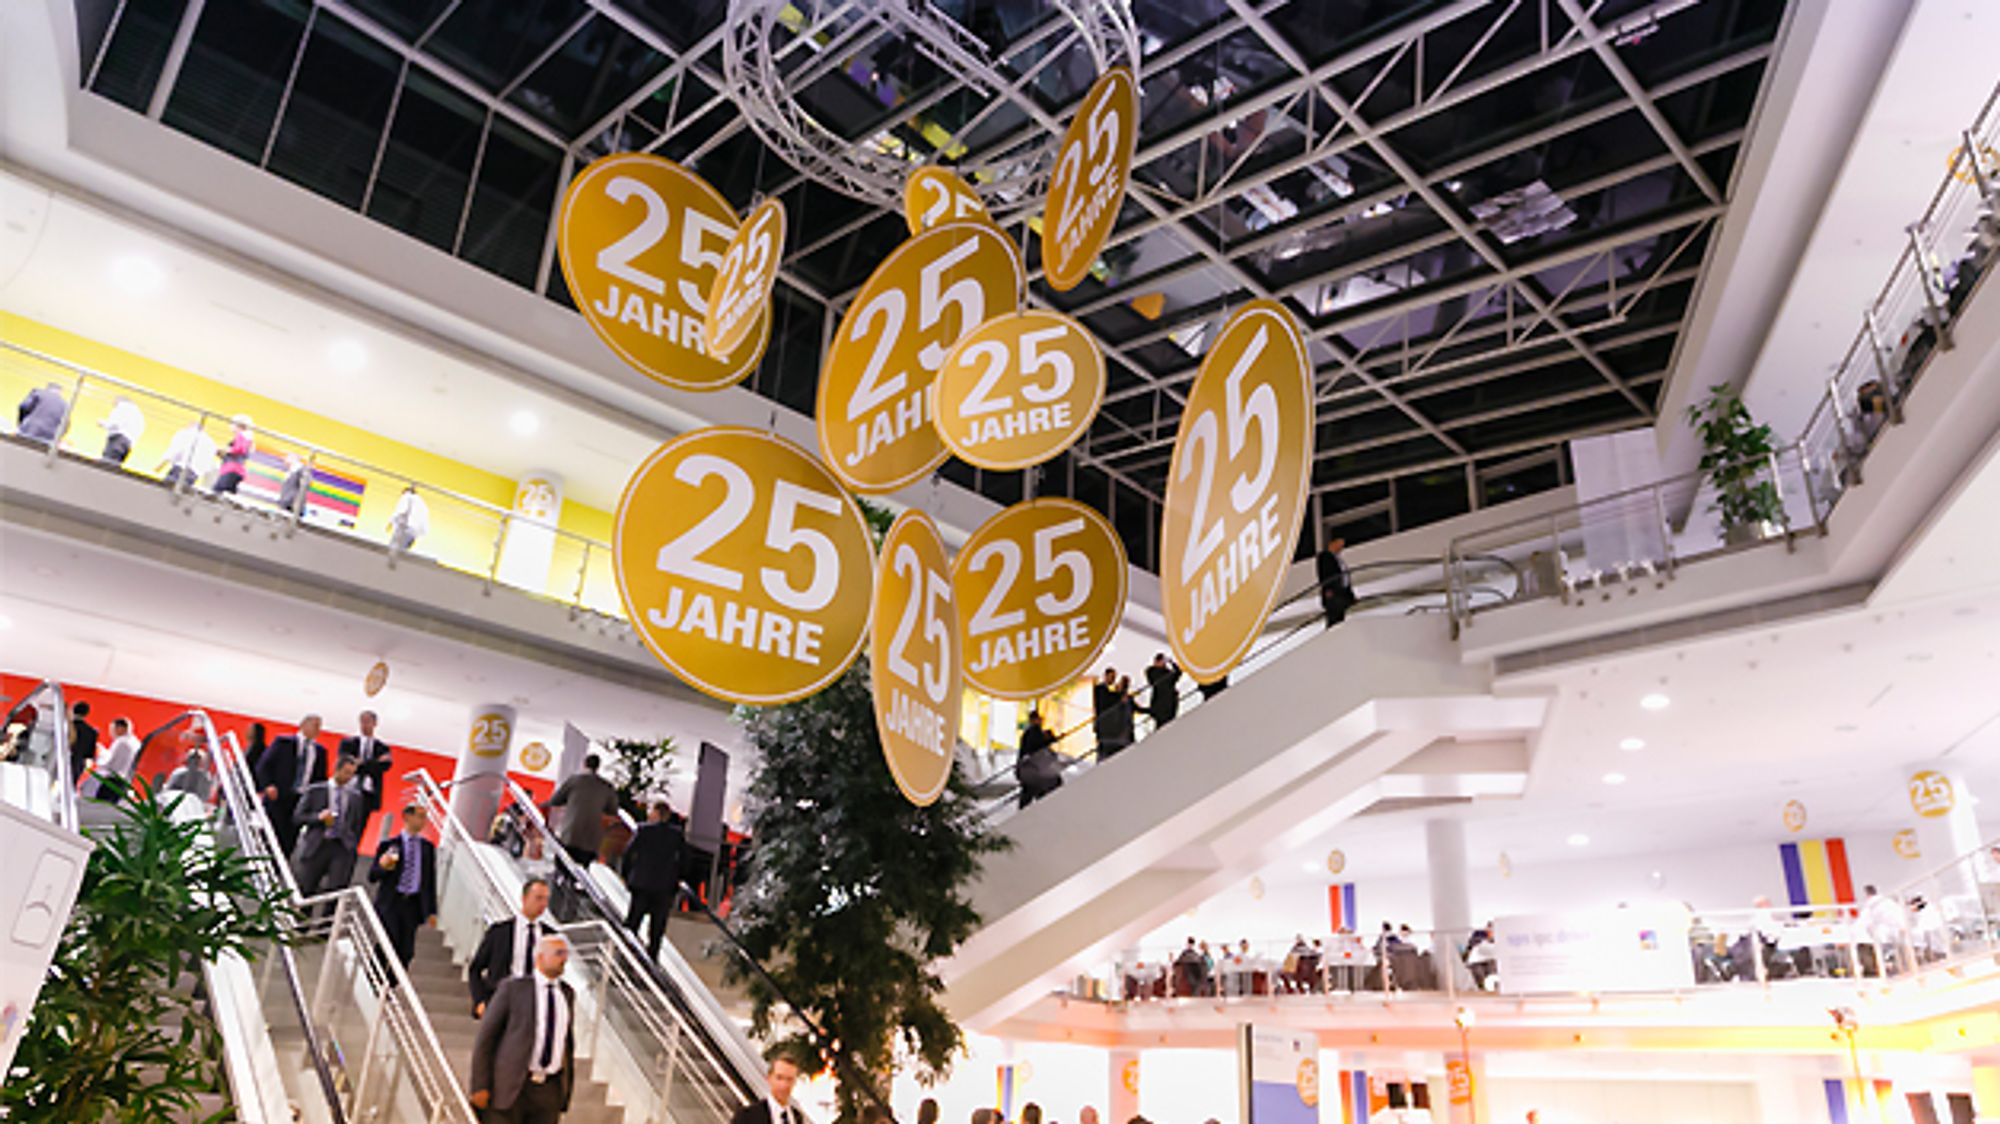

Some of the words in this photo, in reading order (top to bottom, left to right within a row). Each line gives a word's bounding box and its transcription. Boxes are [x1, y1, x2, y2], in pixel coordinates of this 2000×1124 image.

[1055, 79, 1119, 243] 25
[596, 176, 740, 314] 25
[716, 207, 772, 320] 25
[1057, 163, 1119, 274] JAHRE
[593, 286, 729, 364] JAHR
[847, 235, 985, 422] 25
[958, 325, 1075, 419] 25
[846, 383, 933, 467] JAH
[960, 402, 1072, 447] JAHRE
[1178, 324, 1280, 587] 25
[655, 454, 842, 612] 25
[968, 518, 1093, 636] 25
[1183, 493, 1282, 645] JAHRE
[648, 587, 824, 666] JAHRE
[888, 543, 952, 704] 25
[969, 614, 1091, 673] JAHRE
[474, 719, 507, 745] 25
[885, 689, 947, 758] JAHRE
[1910, 776, 1949, 805] 25
